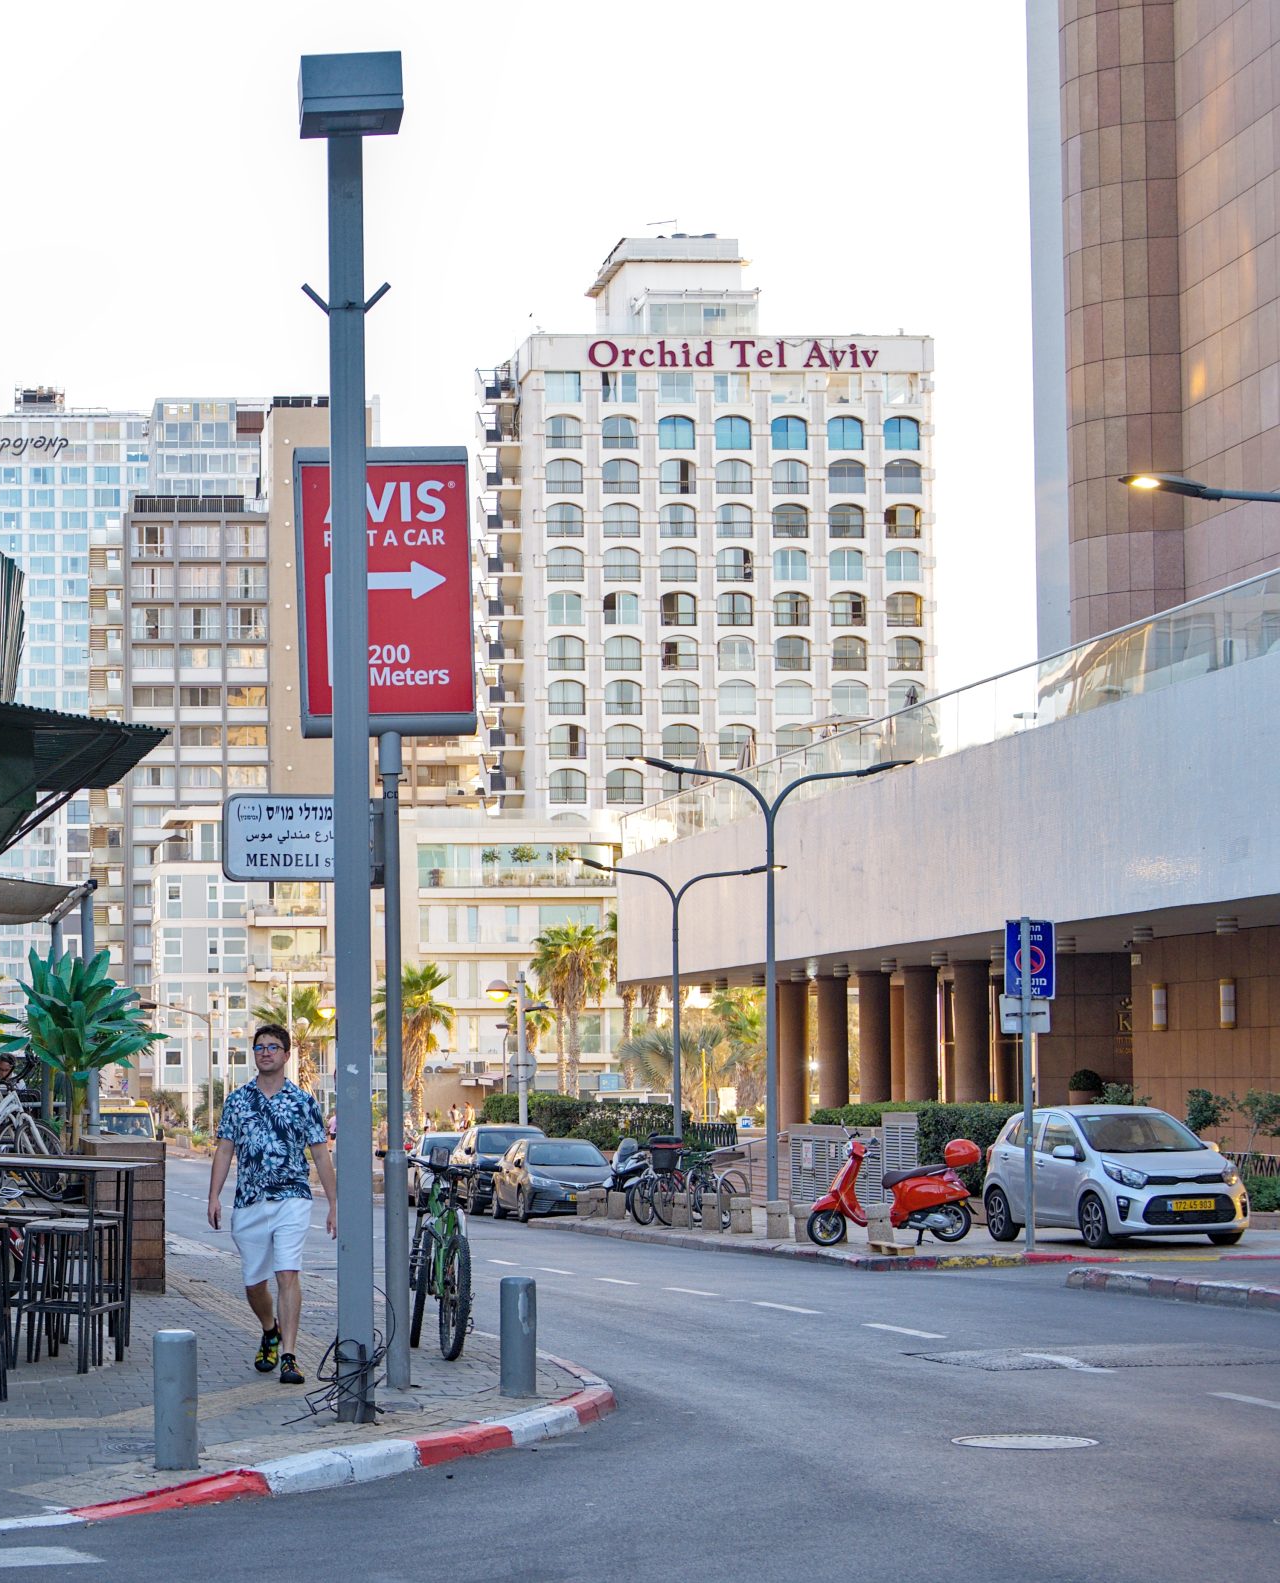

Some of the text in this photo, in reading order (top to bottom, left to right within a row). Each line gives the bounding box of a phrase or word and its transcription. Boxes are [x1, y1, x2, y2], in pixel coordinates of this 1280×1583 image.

[588, 338, 879, 369] Orchid Tel Aviv
[323, 480, 446, 523] VIS
[324, 529, 446, 547] RT A CAR
[368, 644, 410, 664] 200
[370, 667, 450, 686] Meters
[299, 803, 332, 821] מנדלי
[315, 830, 334, 842] ارع
[246, 854, 319, 867] MENDELI
